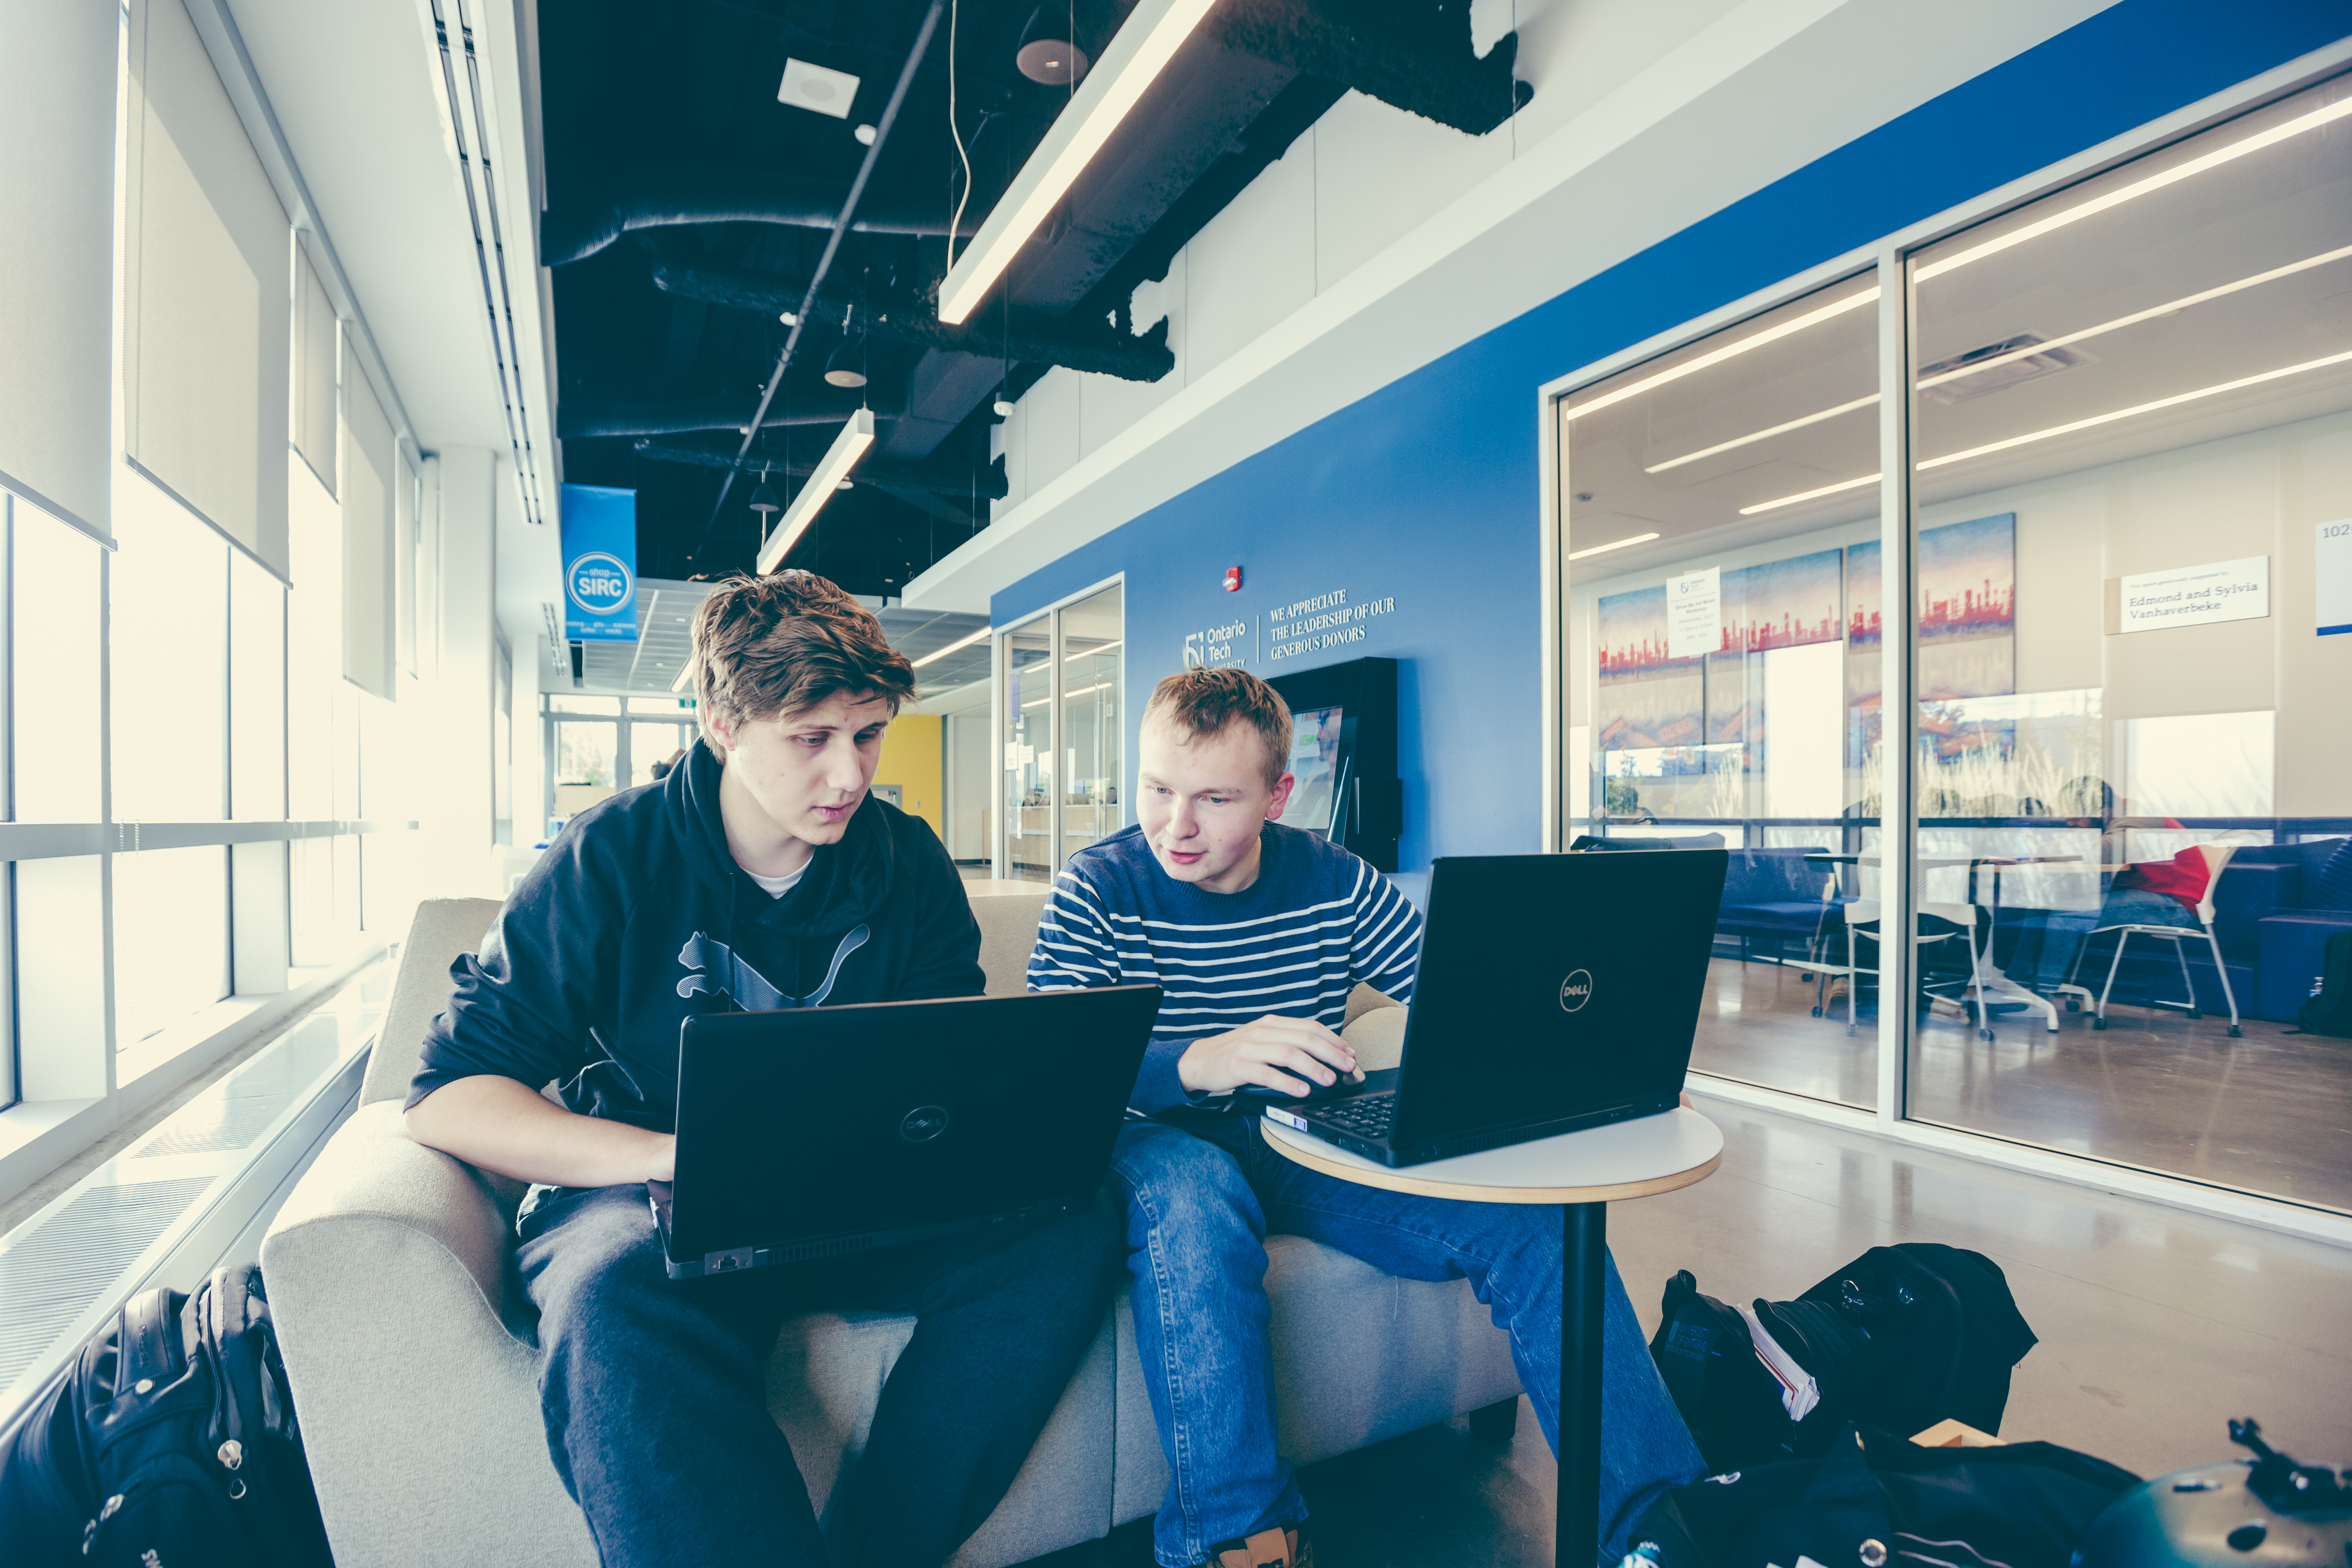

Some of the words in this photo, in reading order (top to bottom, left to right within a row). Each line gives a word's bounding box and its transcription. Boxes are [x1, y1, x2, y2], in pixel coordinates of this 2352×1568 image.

[2322, 524, 2352, 538] 102
[589, 567, 609, 577] shop
[579, 578, 622, 597] SIRC
[2130, 592, 2182, 607] Edmond
[2186, 588, 2211, 600] and
[2215, 583, 2259, 598] Sylvia
[1270, 607, 1285, 623] WE
[1287, 589, 1347, 619] APPRECIATE
[2130, 601, 2222, 620] Vanhaverbeke
[1271, 625, 1290, 641] THE
[1291, 607, 1353, 636] LEADERSHIP
[1354, 603, 1369, 621] OF
[1371, 597, 1395, 616] OUR
[1207, 619, 1246, 644] Ontario
[1208, 641, 1232, 662] Tech
[1271, 638, 1321, 660] GENEROUS
[1323, 625, 1367, 647] DONORS
[1564, 985, 1588, 997] DELL
[905, 1118, 942, 1130] DELL
[1679, 1323, 1711, 1339] UNIVERSITY
[1677, 1334, 1685, 1344] OF
[1684, 1336, 1707, 1352] ONTARIO
